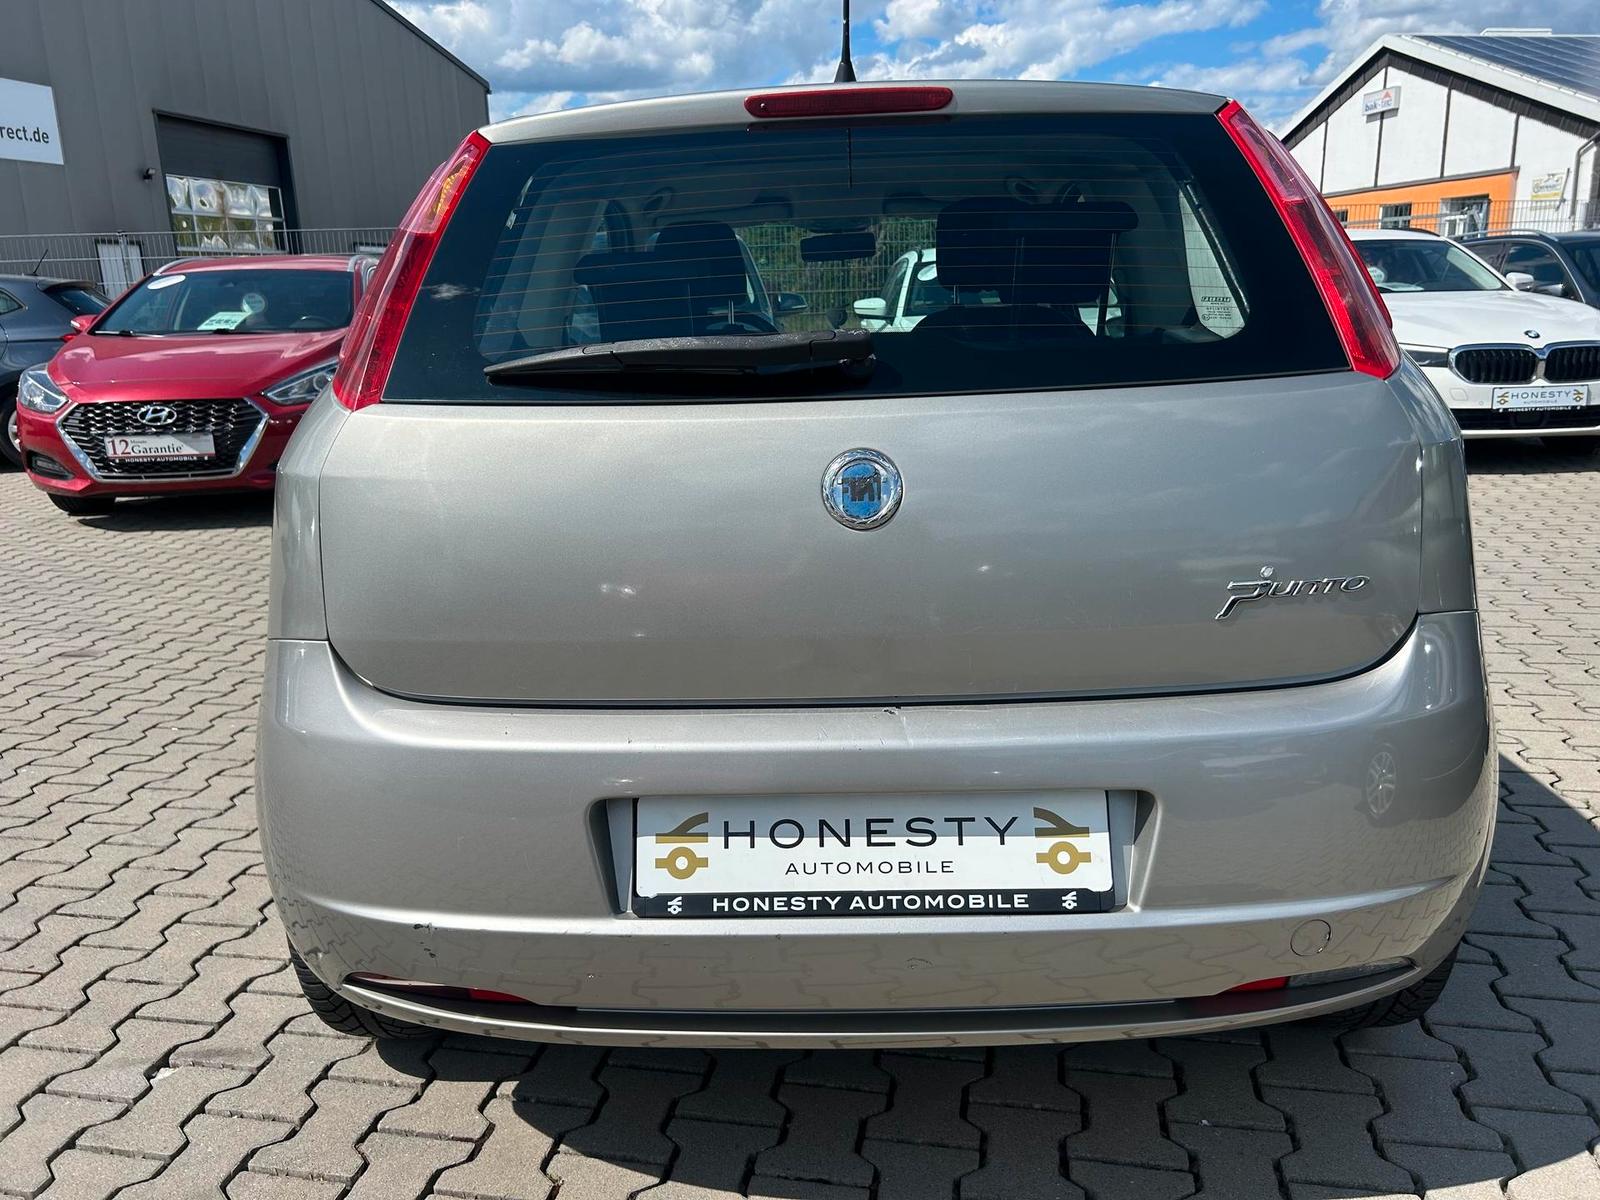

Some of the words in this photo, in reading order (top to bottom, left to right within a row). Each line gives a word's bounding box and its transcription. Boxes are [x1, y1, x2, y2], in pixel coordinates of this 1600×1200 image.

[1511, 390, 1571, 399] HONESTY
[107, 439, 131, 456] 12
[723, 816, 1018, 849] HONESTY
[785, 861, 955, 876] AUTOMOBILE
[712, 895, 842, 912] HONESTY
[849, 893, 1029, 911] AUTOMOBILE
